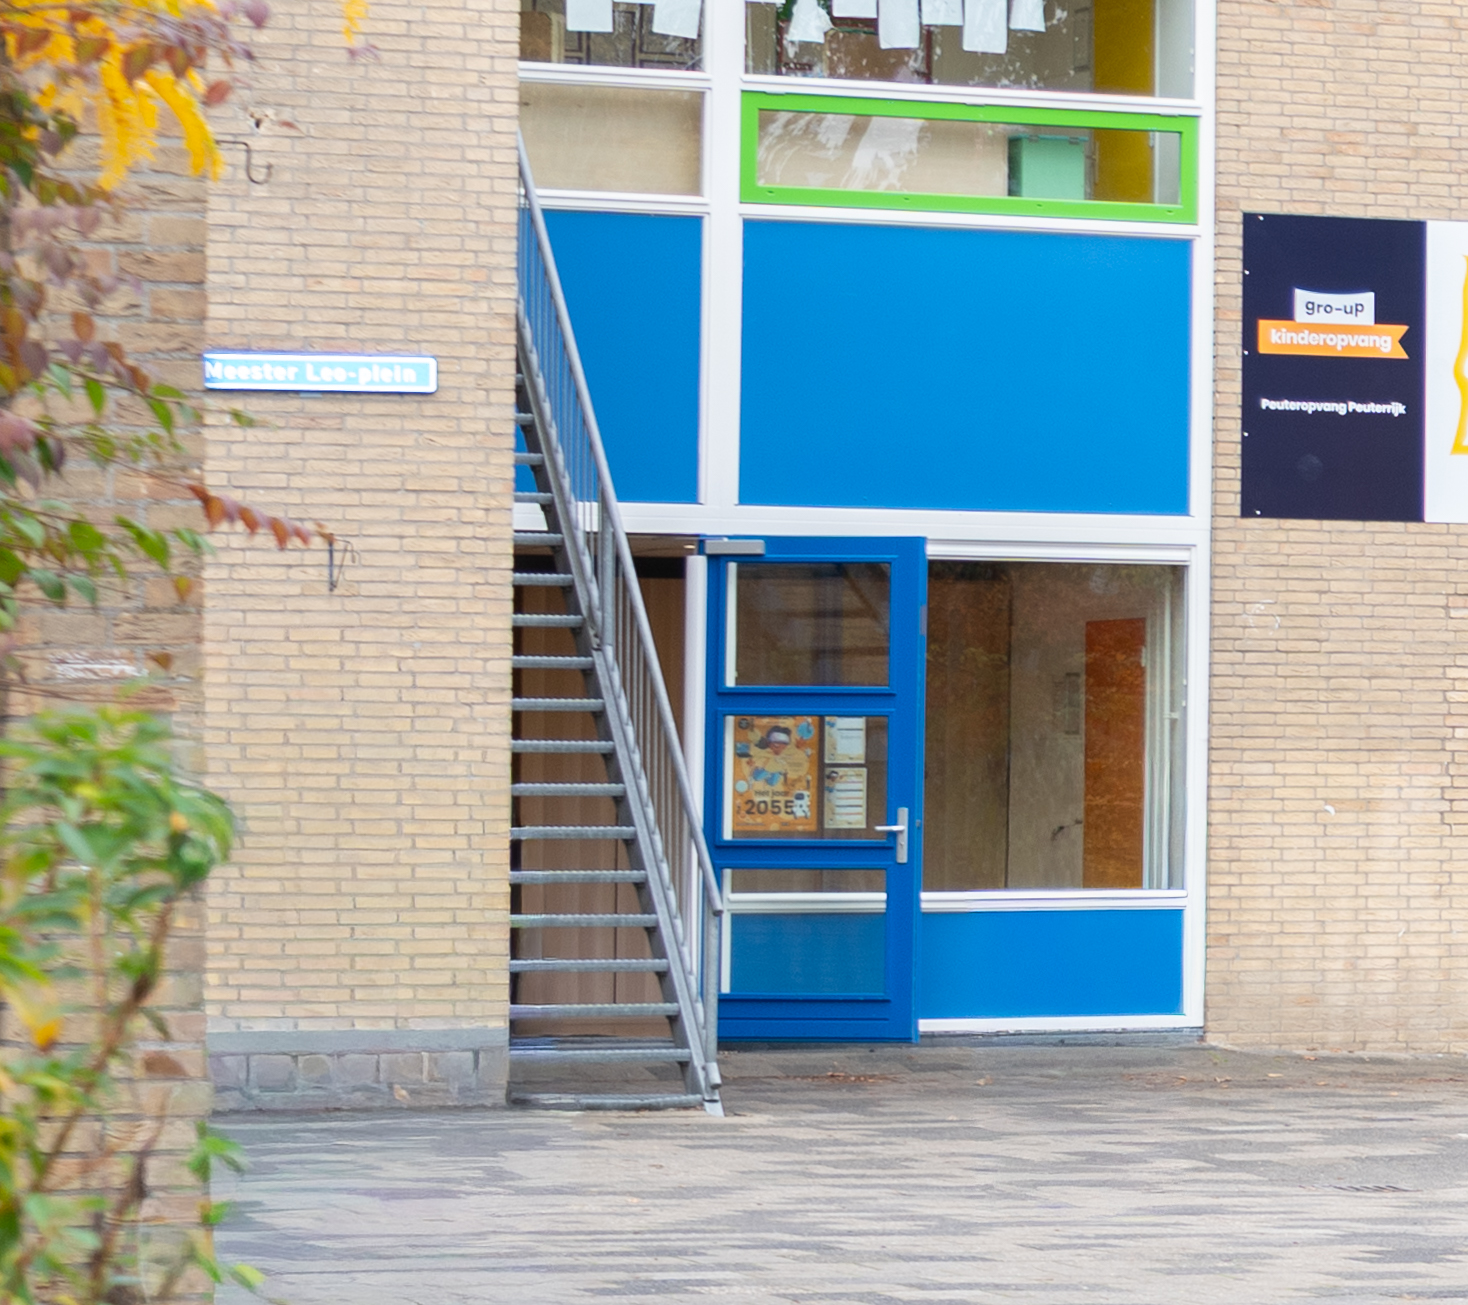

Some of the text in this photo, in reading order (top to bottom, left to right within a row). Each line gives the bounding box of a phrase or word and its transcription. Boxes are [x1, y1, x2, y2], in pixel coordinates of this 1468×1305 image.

[1305, 301, 1365, 317] gro-up
[1270, 329, 1392, 353] kinderopvang
[205, 361, 417, 385] Meester Leo-plein
[1260, 398, 1407, 417] Peuteropvang Peuterrijk
[745, 799, 795, 815] 2055
